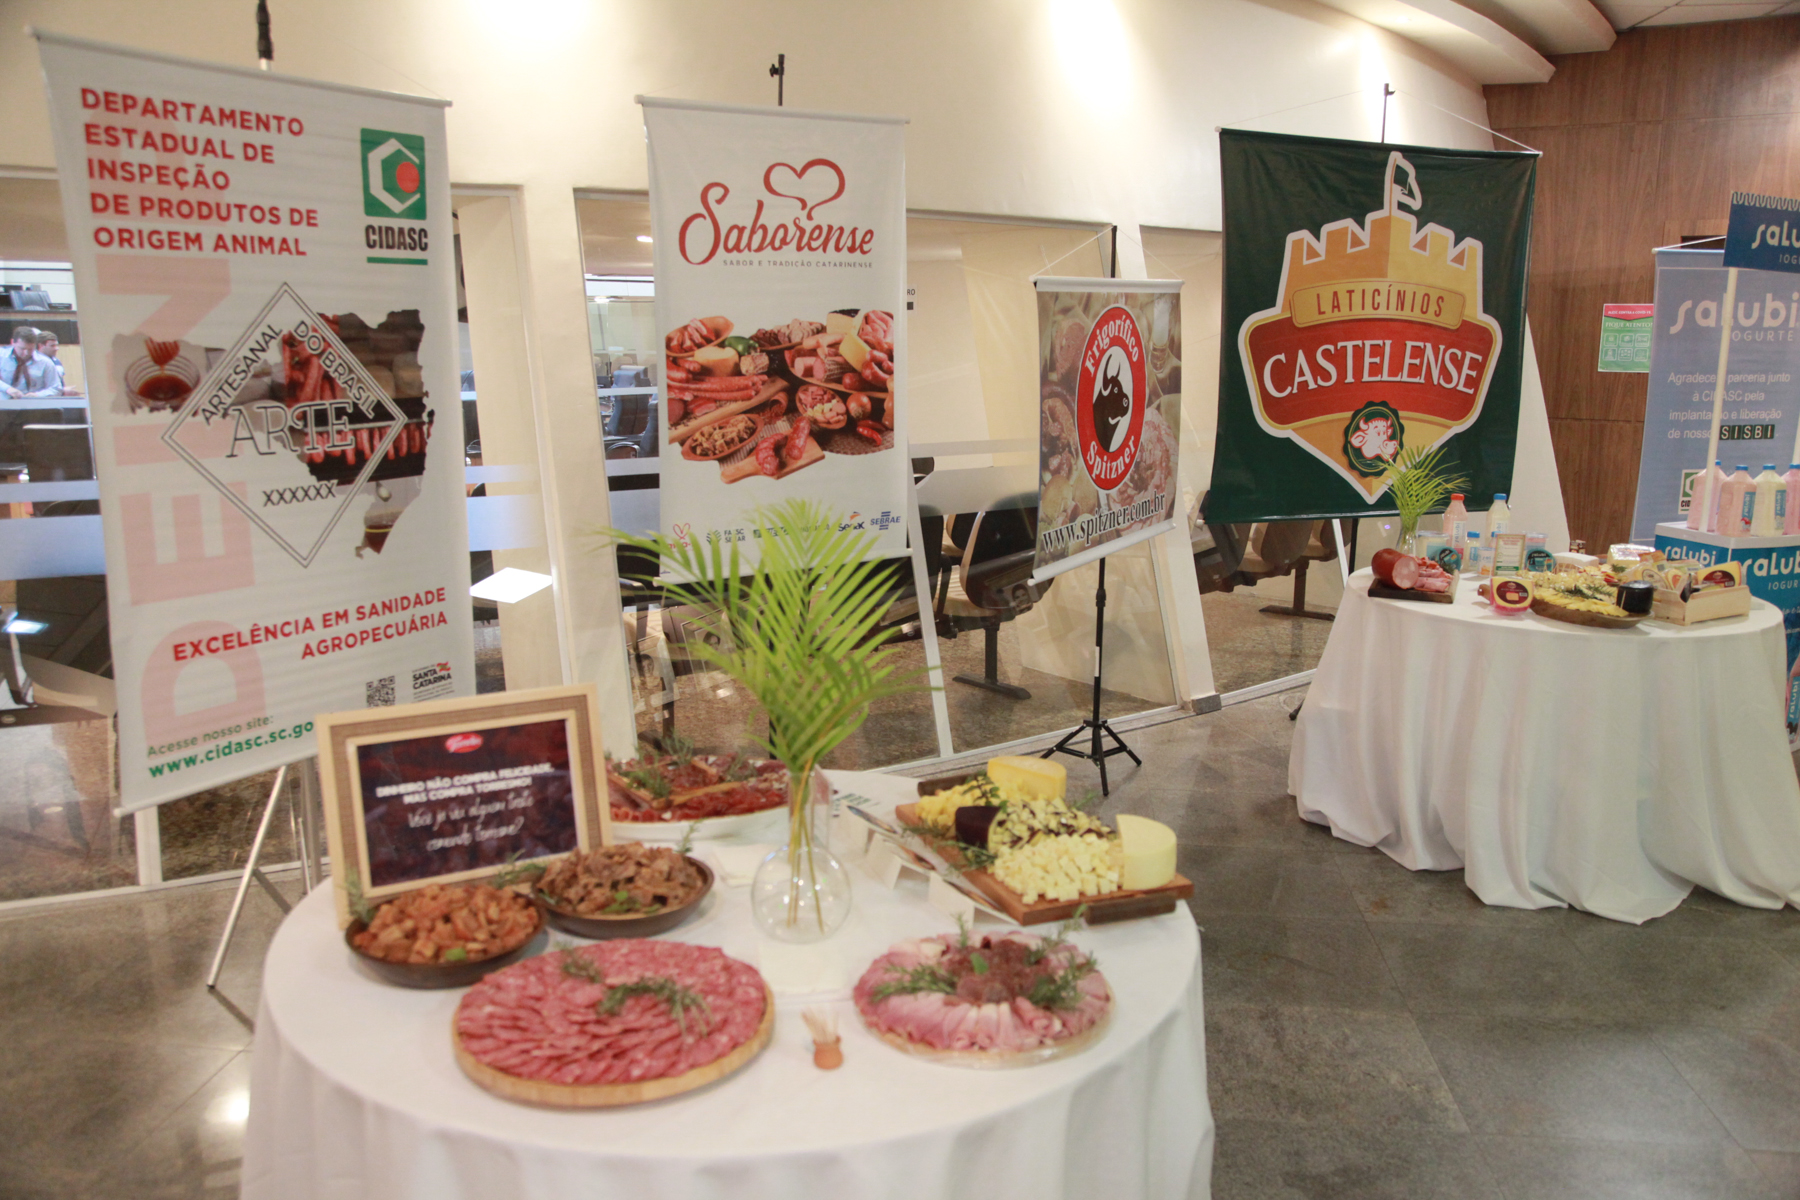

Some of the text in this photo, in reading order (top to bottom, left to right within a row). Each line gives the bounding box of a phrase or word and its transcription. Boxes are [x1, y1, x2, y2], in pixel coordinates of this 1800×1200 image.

[80, 87, 304, 136] DEPARTAMENTO
[84, 123, 275, 164] ESTADUAL DE
[87, 158, 230, 191] INSPEÇÃO
[90, 192, 319, 228] DE PRODUTOS DE
[678, 181, 875, 266] Saborense
[93, 227, 308, 257] ORIGEM ANIMAL
[364, 224, 429, 253] CIDASC
[723, 259, 754, 267] SABOR
[767, 259, 813, 269] TRADIÇÃO
[816, 260, 873, 268] CATARINENSE
[1316, 284, 1445, 318] LATICÍNIOS
[1085, 315, 1139, 377] Frigorífico
[1731, 330, 1794, 341] OGURTE
[200, 320, 381, 426] ARTESANAL DO BRASIL
[1262, 339, 1483, 399] CASTELENSE
[1728, 372, 1766, 385] parceria
[1766, 372, 1791, 385] junto
[1702, 390, 1743, 402] CIASC
[1744, 391, 1765, 403] pela
[225, 399, 356, 458] ARTE
[1731, 411, 1738, 420] e
[1740, 408, 1782, 421] liberação
[1668, 428, 1680, 439] de
[1087, 435, 1137, 480] Spitzner
[724, 528, 745, 536] FASC
[870, 515, 902, 526] SEBRAE
[1042, 490, 1166, 554] www.spitzner.com.br
[725, 535, 747, 543] SEAR
[173, 587, 447, 662] EXCELÊNCIA EM SANIDADE
[301, 611, 448, 660] AGROPECUÁRIA
[413, 668, 438, 682] SANTA
[413, 672, 452, 690] CATARINA
[147, 714, 274, 759] Acesse nosso site:
